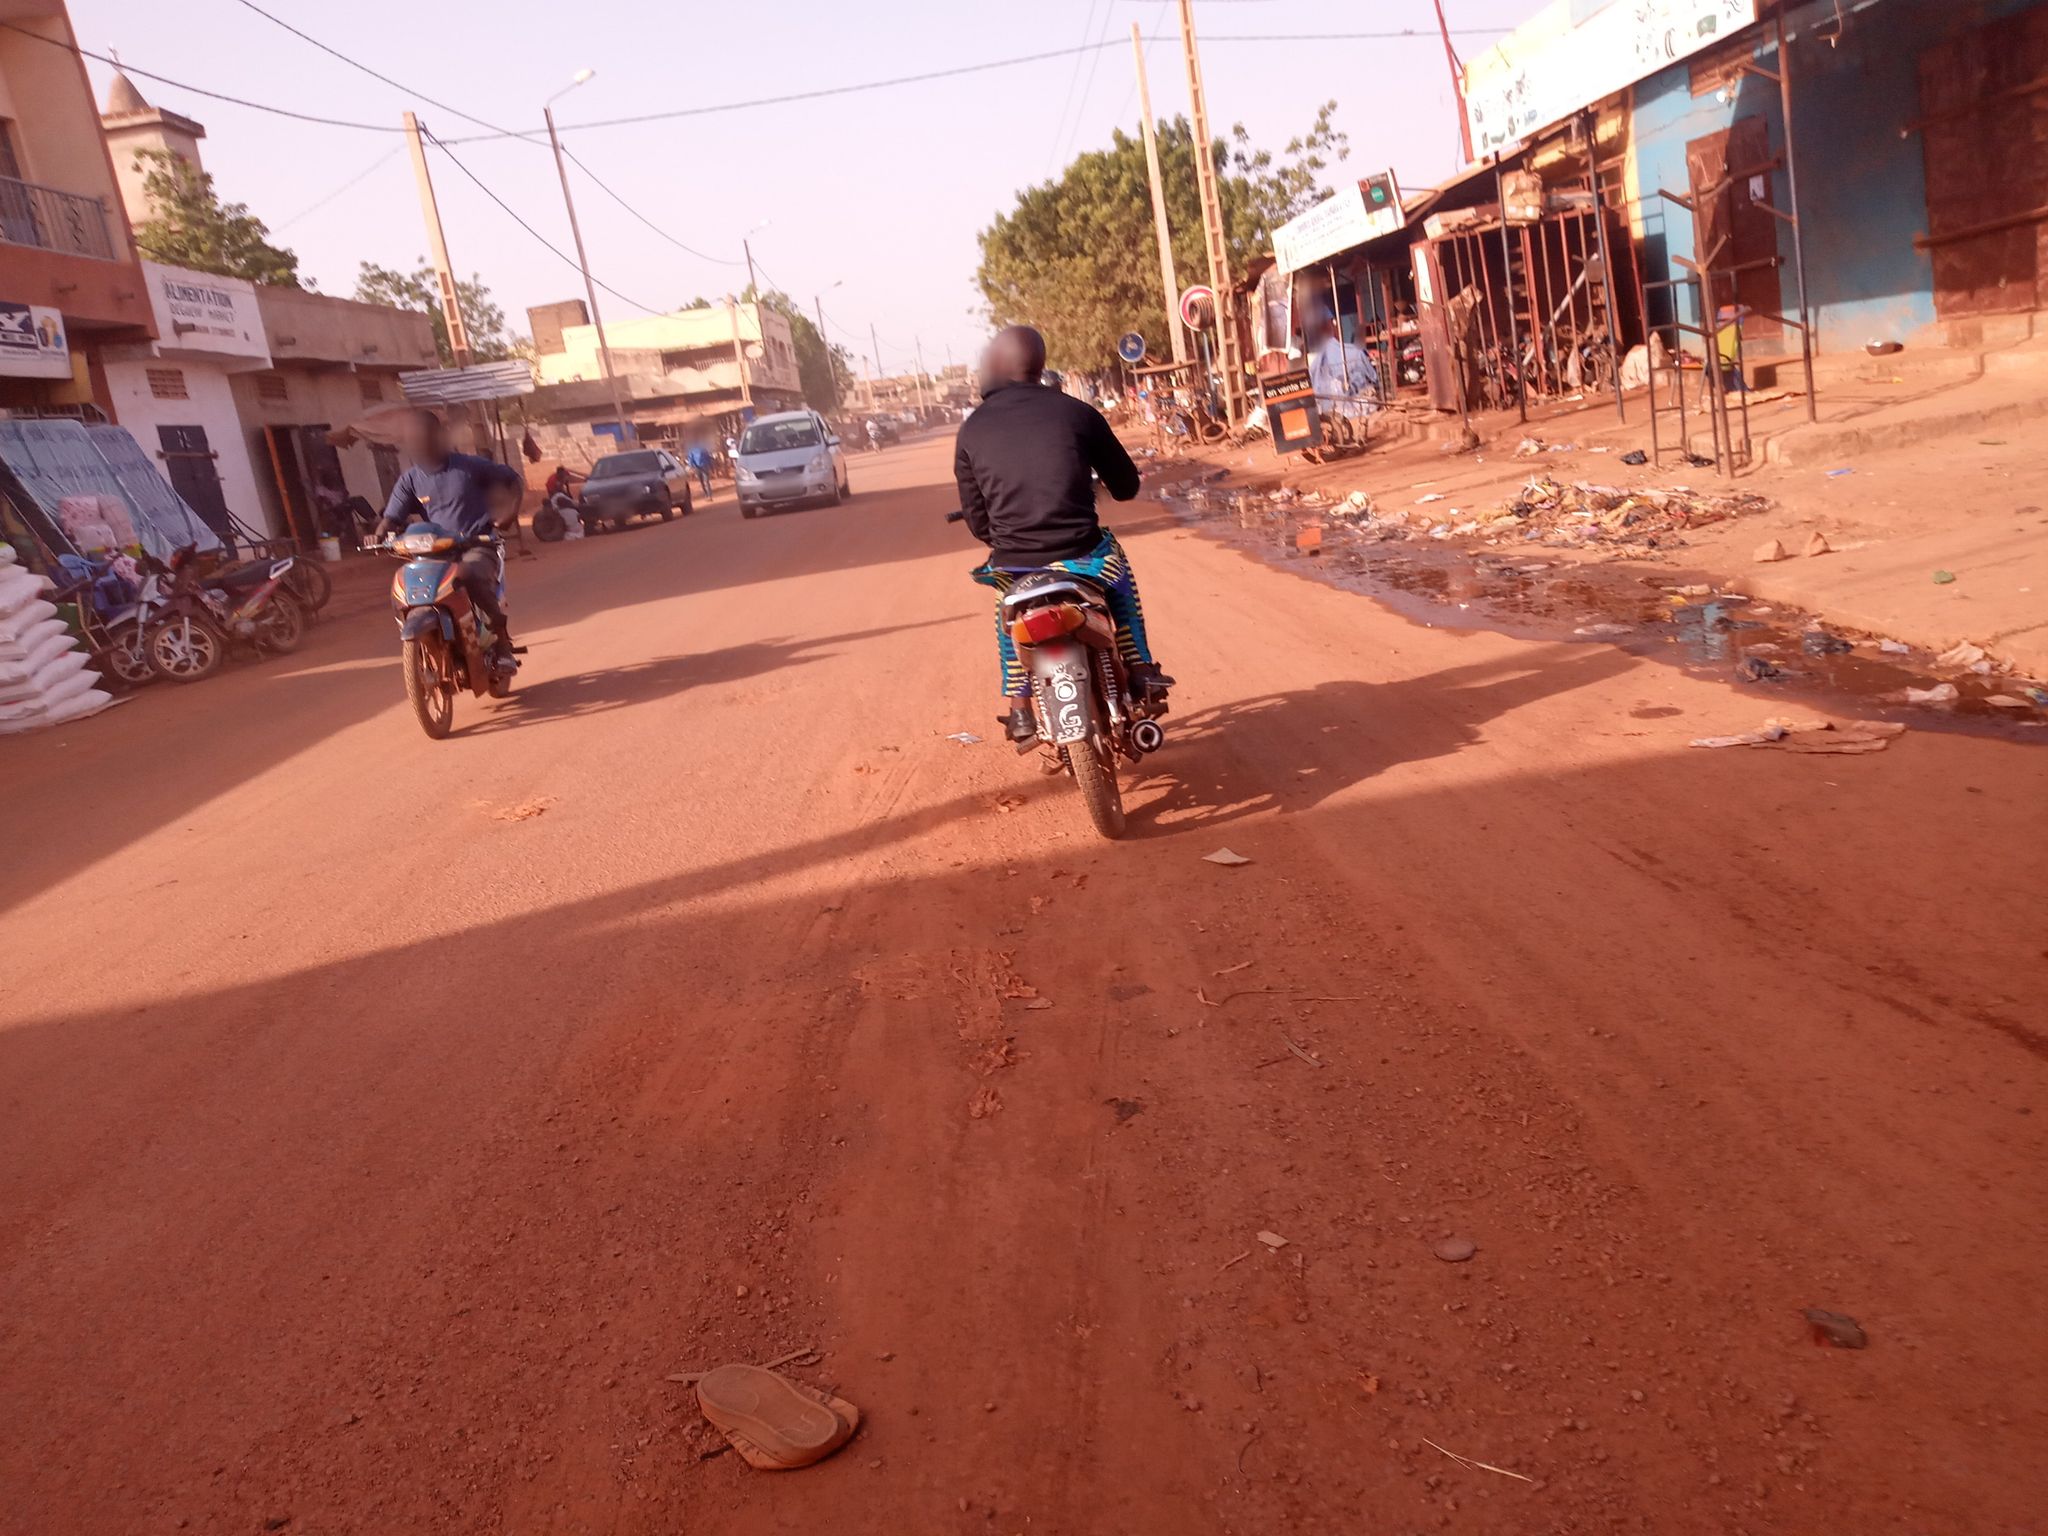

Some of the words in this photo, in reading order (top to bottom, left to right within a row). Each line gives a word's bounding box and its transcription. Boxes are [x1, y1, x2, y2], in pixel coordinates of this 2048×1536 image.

[164, 282, 234, 309] ALIMENTATION
[1266, 389, 1277, 398] en
[1278, 384, 1300, 395] vente
